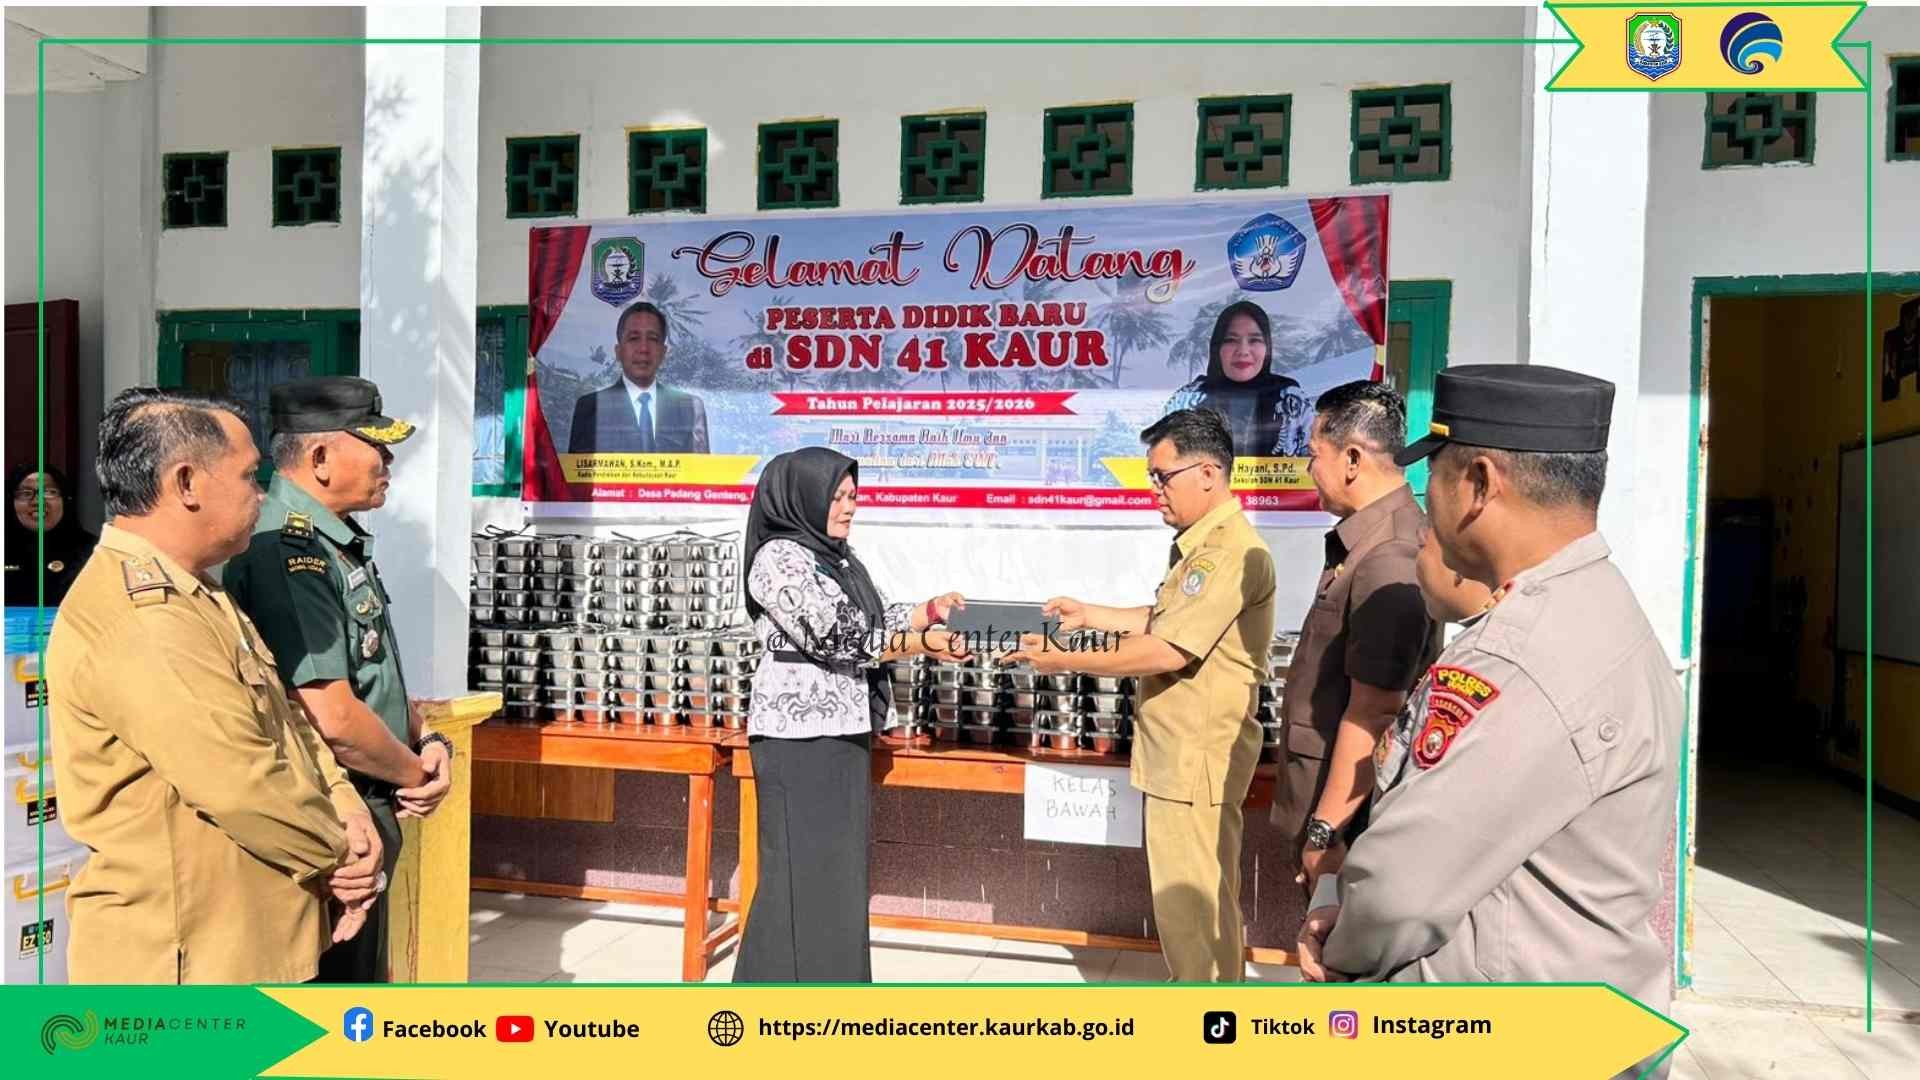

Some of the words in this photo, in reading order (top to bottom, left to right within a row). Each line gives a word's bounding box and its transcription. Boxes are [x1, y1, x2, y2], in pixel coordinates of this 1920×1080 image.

[671, 231, 924, 297] Selamat
[943, 222, 1196, 303] Datang
[766, 306, 893, 333] PESERTA
[902, 304, 991, 329] DIDIK
[999, 303, 1087, 328] BARU
[745, 346, 773, 370] di
[786, 334, 882, 369] SDN
[897, 338, 947, 372] 41
[964, 332, 1109, 368] KAUR
[807, 398, 857, 410] Tahun
[863, 398, 941, 412] Pelajaran
[947, 398, 1035, 411] 2025/2026
[592, 488, 625, 498] Alamat
[638, 489, 662, 498] Desa
[664, 489, 701, 501] Padang
[876, 493, 930, 505] Kabupaten
[933, 493, 957, 503] Kaur
[986, 494, 1016, 504] Email
[1028, 494, 1152, 507] sdn41kaur@gmail.com
[1245, 495, 1279, 505] 38963
[288, 556, 327, 569] RAIDER
[1438, 669, 1493, 697] POLRES
[1053, 774, 1117, 797] KELAS
[1046, 799, 1117, 821] BAWAH
